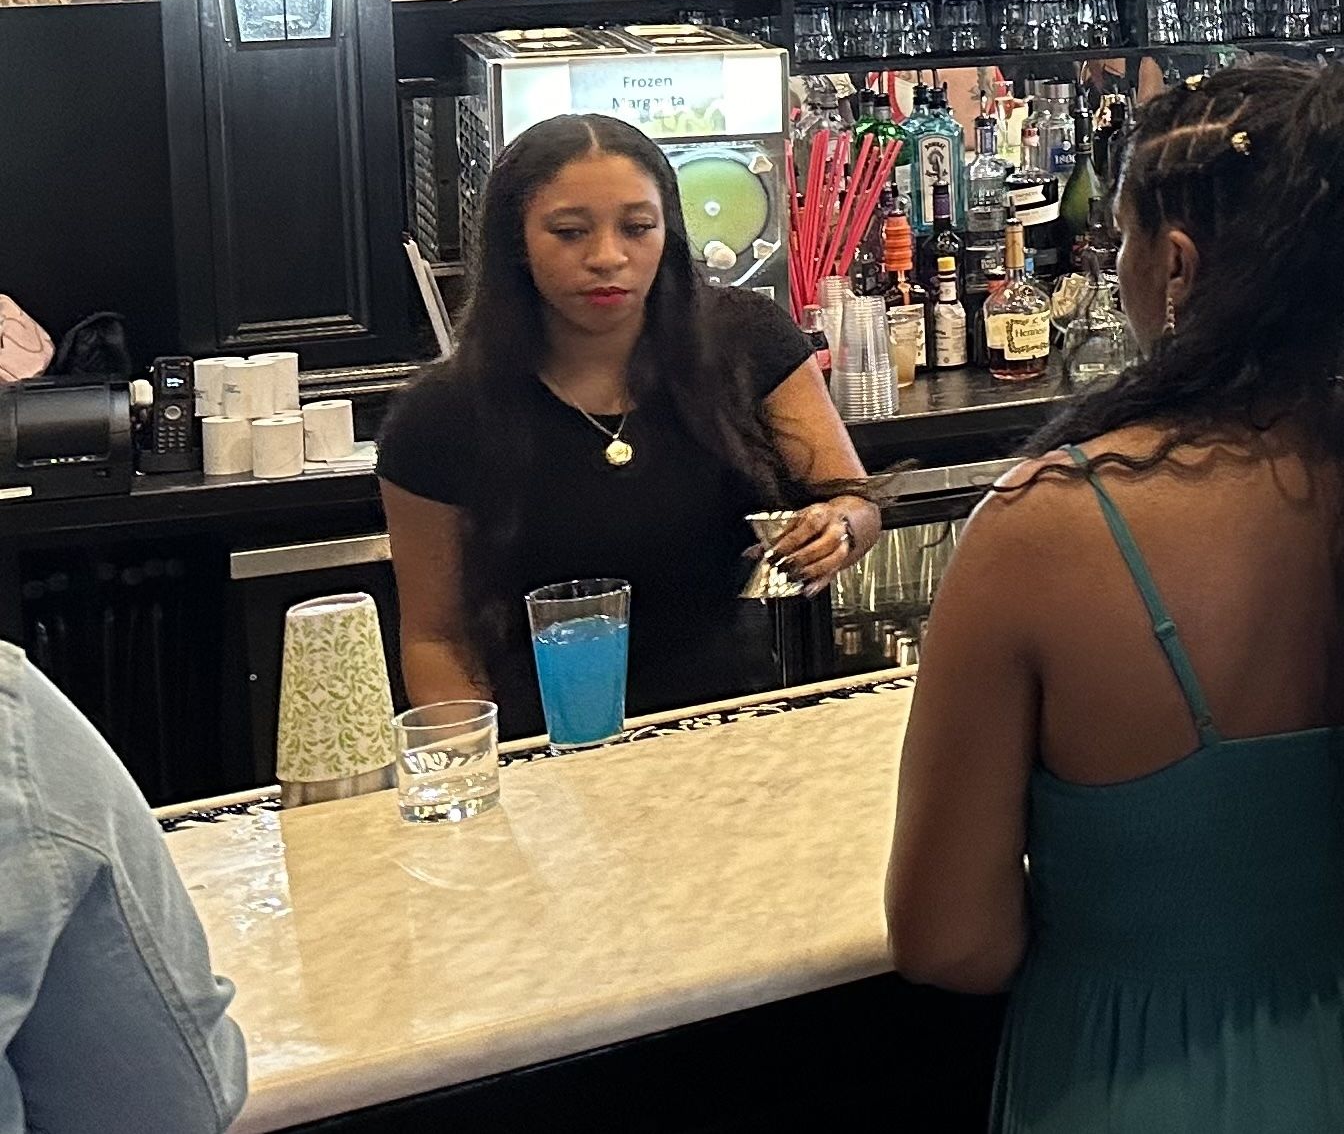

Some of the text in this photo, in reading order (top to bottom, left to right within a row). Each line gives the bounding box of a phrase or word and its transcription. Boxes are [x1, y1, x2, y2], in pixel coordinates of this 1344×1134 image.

[623, 76, 673, 88] Frozen
[612, 95, 685, 111] Margta
[1014, 326, 1049, 338] Hennes
